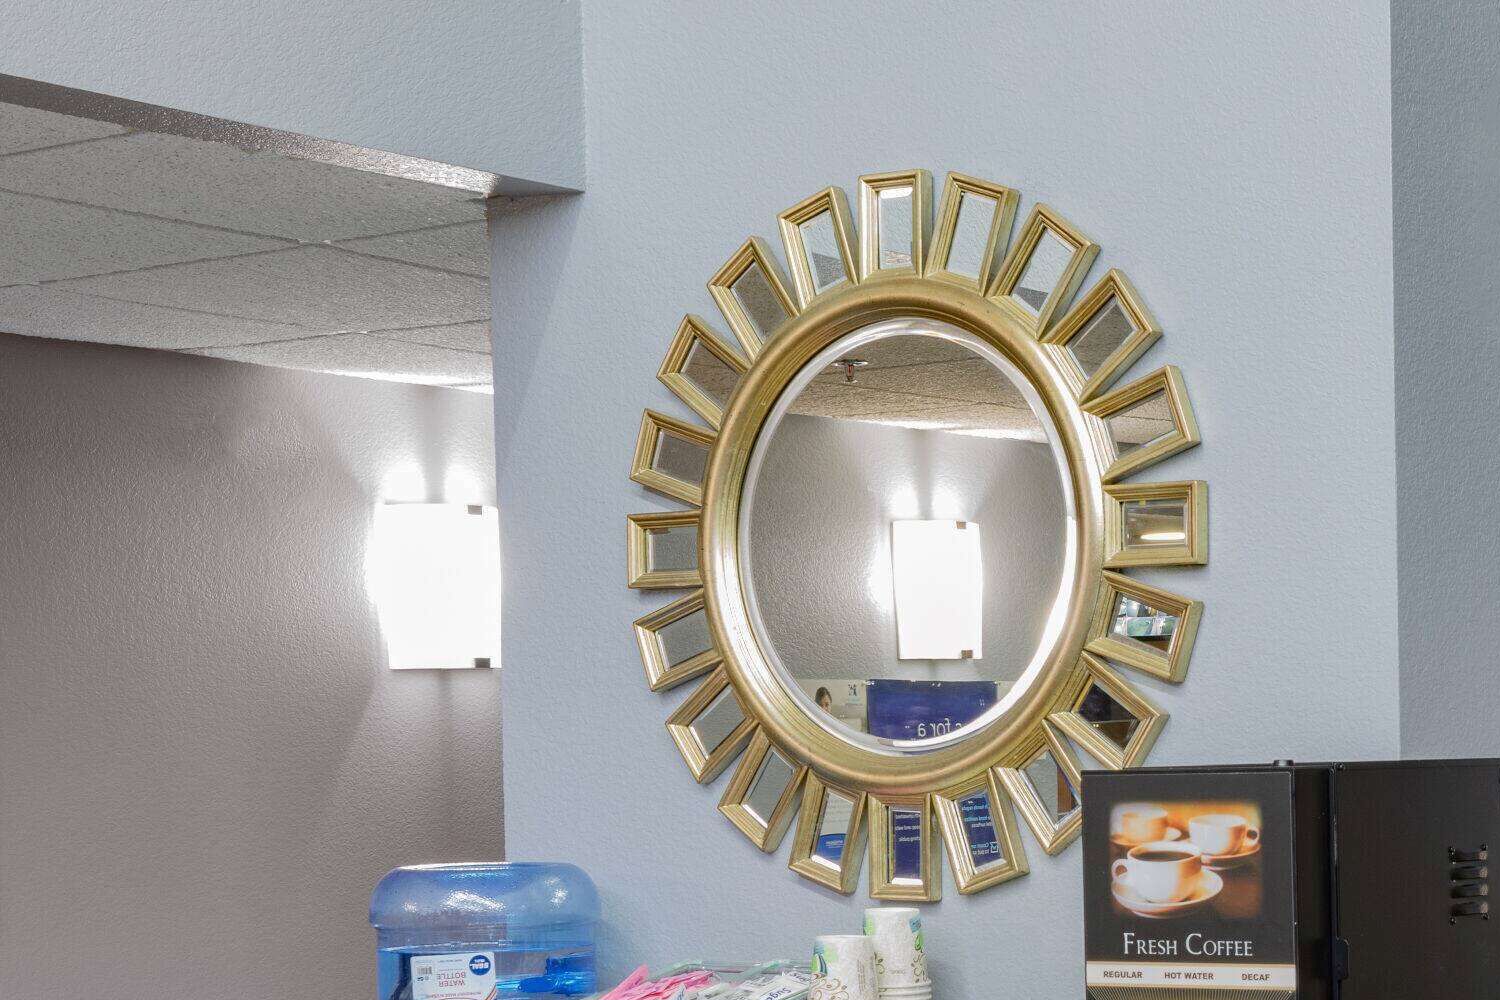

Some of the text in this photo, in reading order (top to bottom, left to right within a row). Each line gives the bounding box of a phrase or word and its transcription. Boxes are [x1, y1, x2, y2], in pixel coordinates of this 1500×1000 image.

[1103, 970, 1143, 979] REGULAR
[1164, 971, 1214, 981] HOT WATER
[1241, 973, 1271, 982] DECAF
[438, 980, 466, 988] WATER
